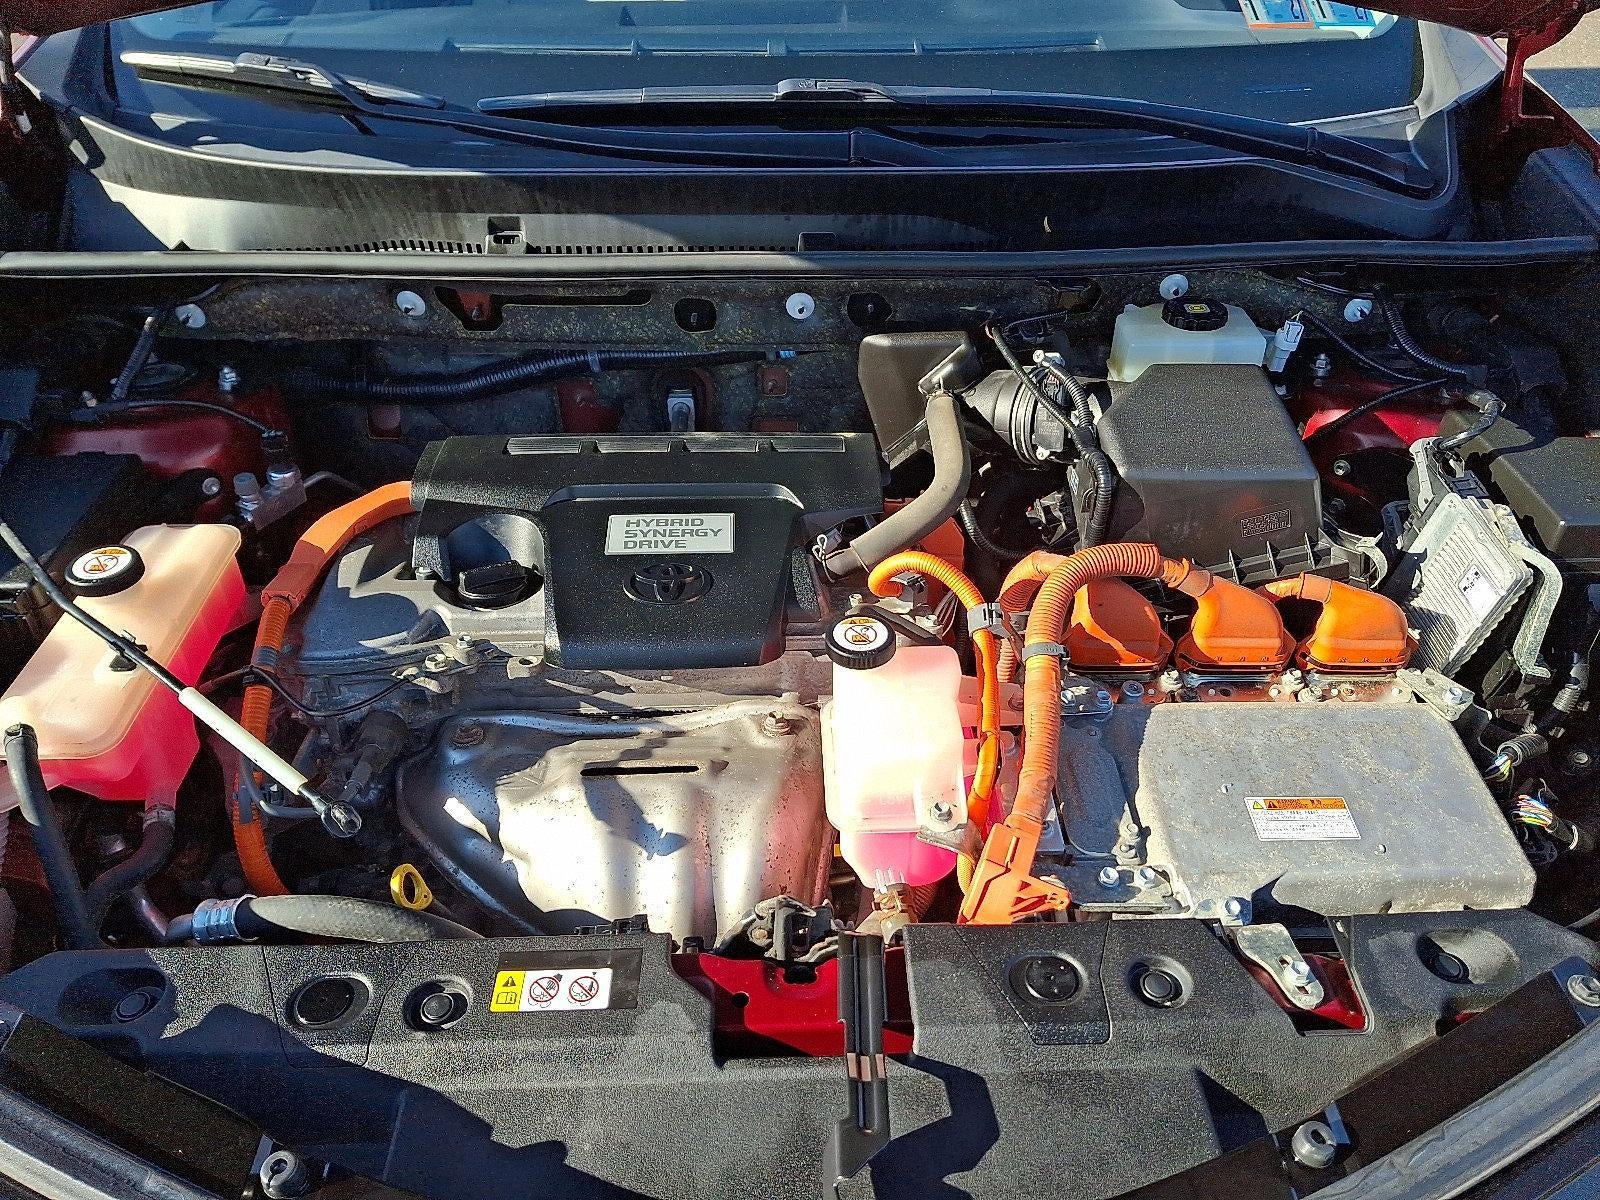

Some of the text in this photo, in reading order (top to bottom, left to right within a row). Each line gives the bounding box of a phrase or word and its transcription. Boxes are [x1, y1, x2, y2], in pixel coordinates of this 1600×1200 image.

[625, 518, 705, 528] HYBRID
[624, 528, 723, 539] SYNERGY
[623, 539, 688, 550] DRIVE
